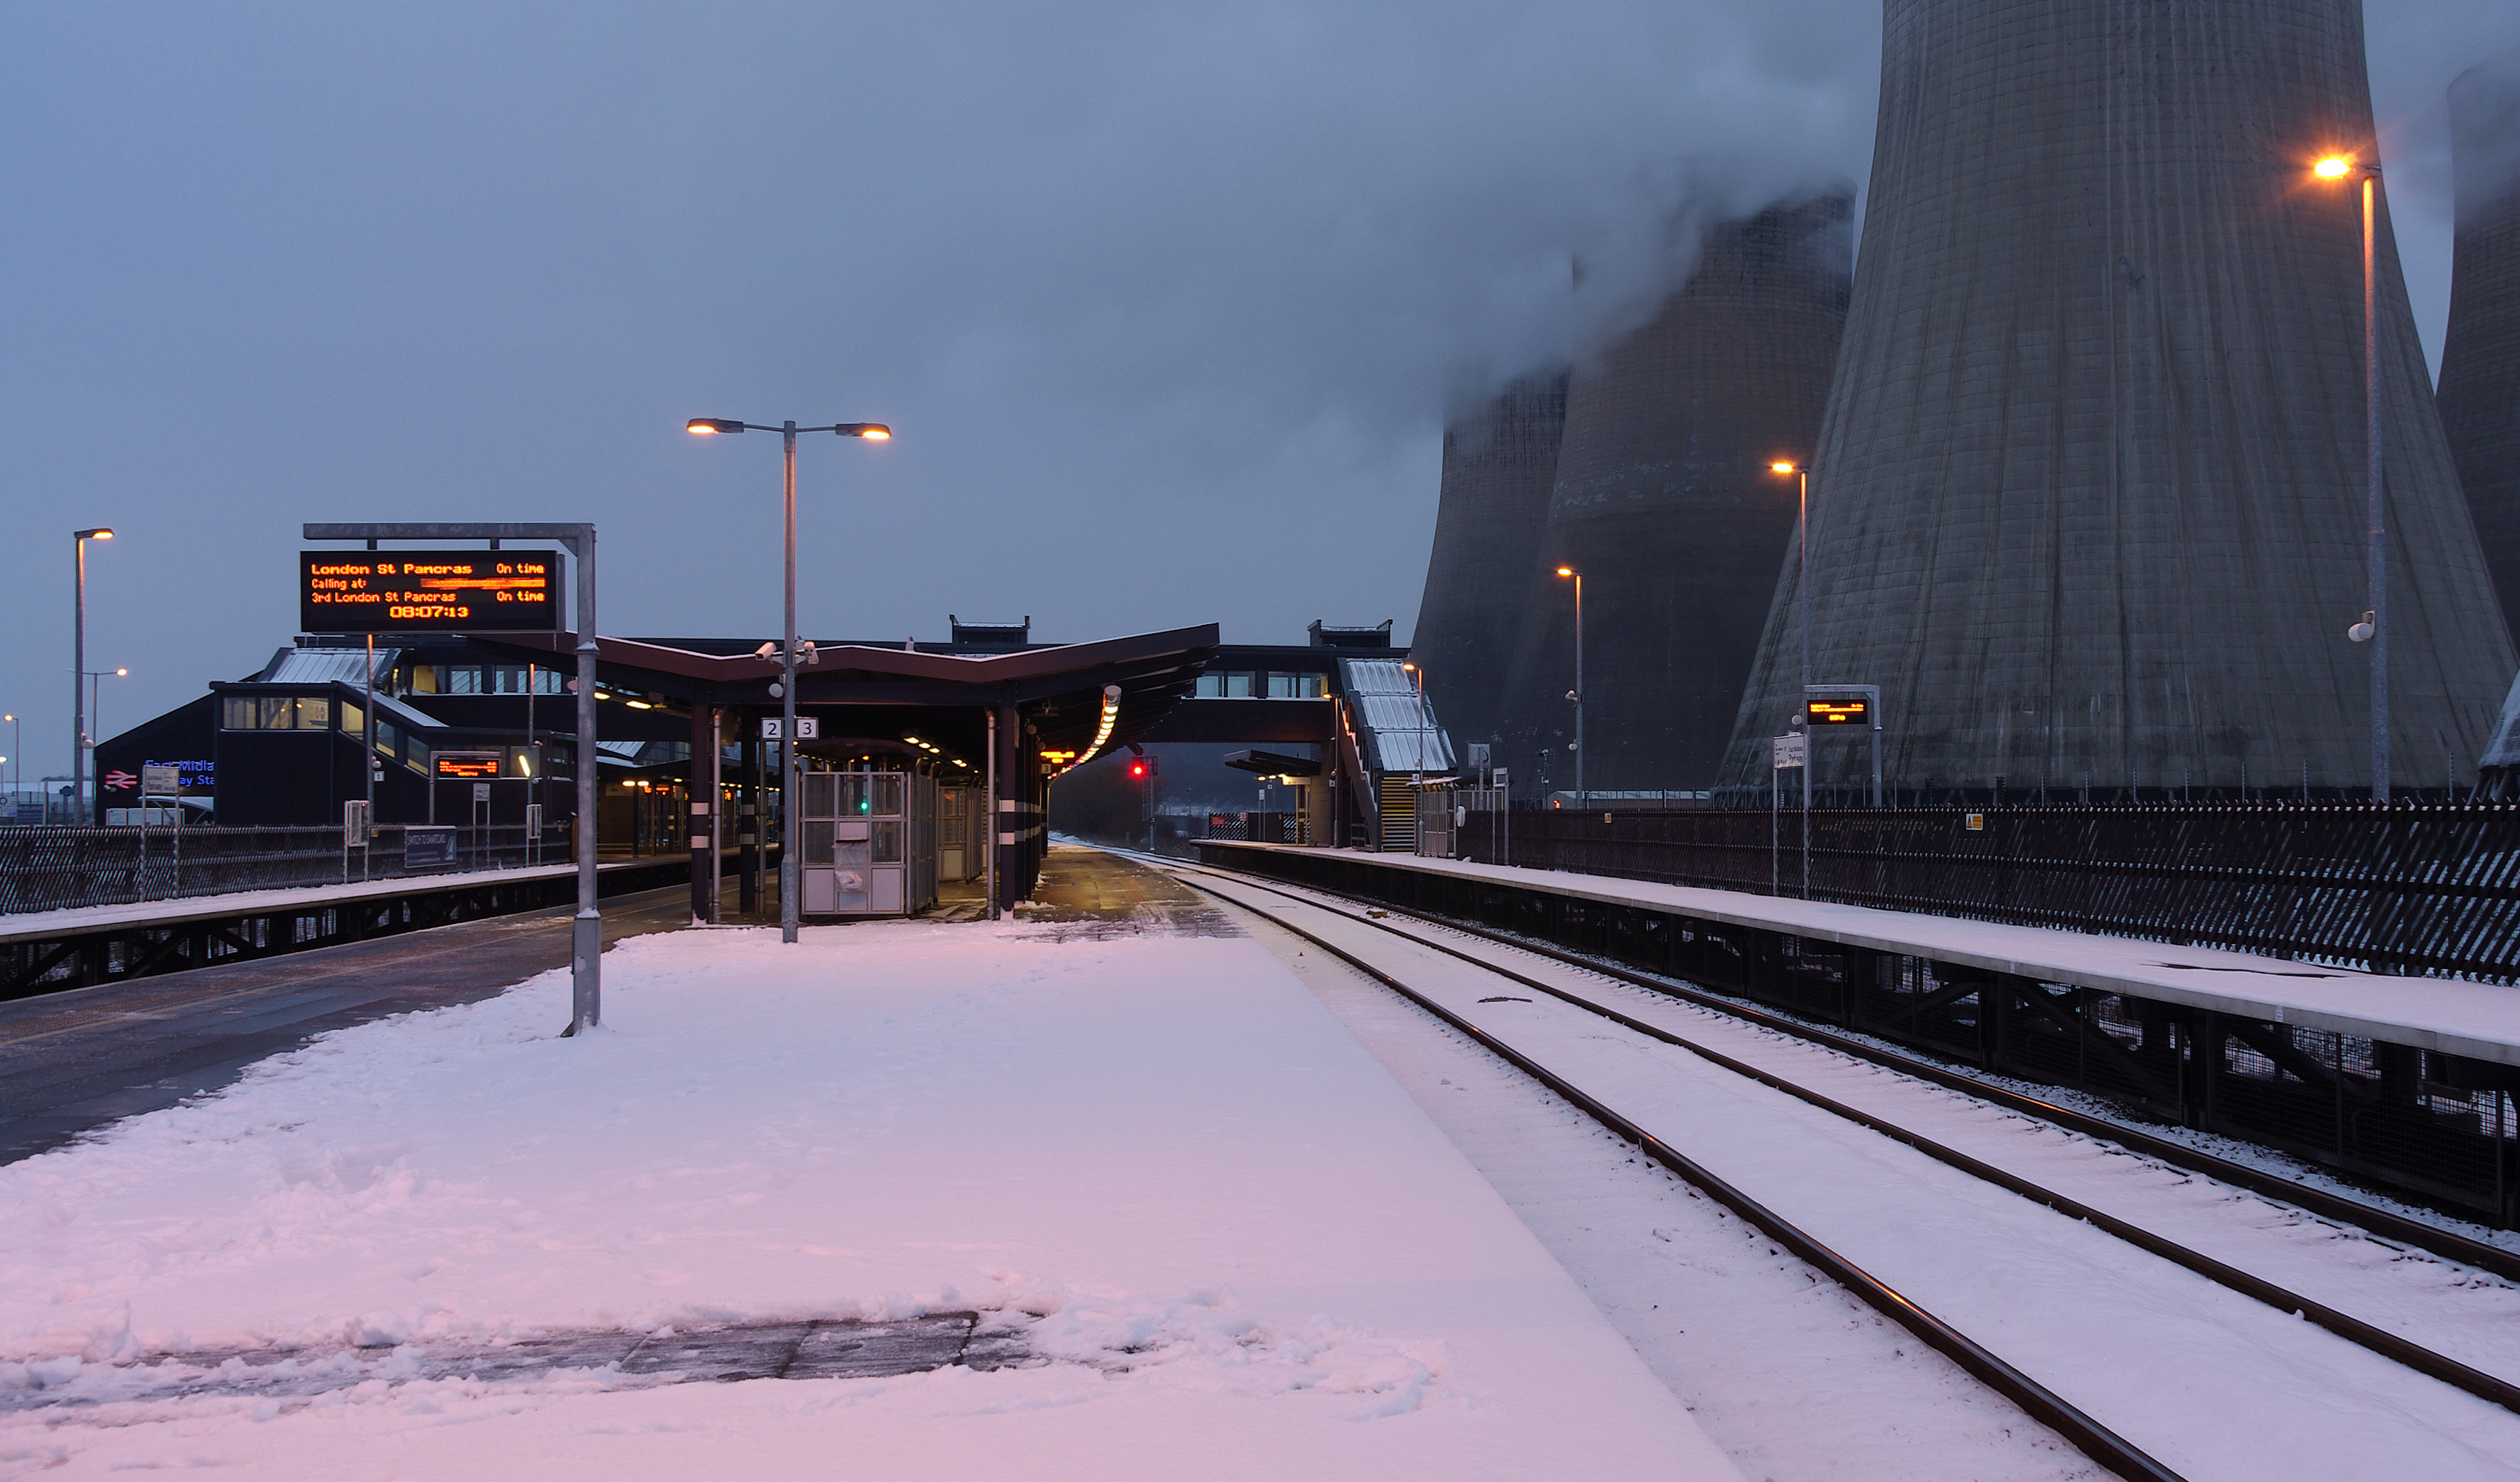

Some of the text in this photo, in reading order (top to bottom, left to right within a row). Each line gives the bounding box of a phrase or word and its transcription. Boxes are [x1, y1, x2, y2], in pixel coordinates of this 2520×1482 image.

[311, 563, 473, 575] London St Pancras
[496, 563, 545, 574] On time
[312, 578, 367, 591] Calling at:
[312, 592, 457, 603] 3rd London St Pancras
[497, 591, 545, 602] On time
[389, 605, 470, 618] 08:07:13
[768, 723, 777, 736] 2
[803, 723, 812, 735] 3
